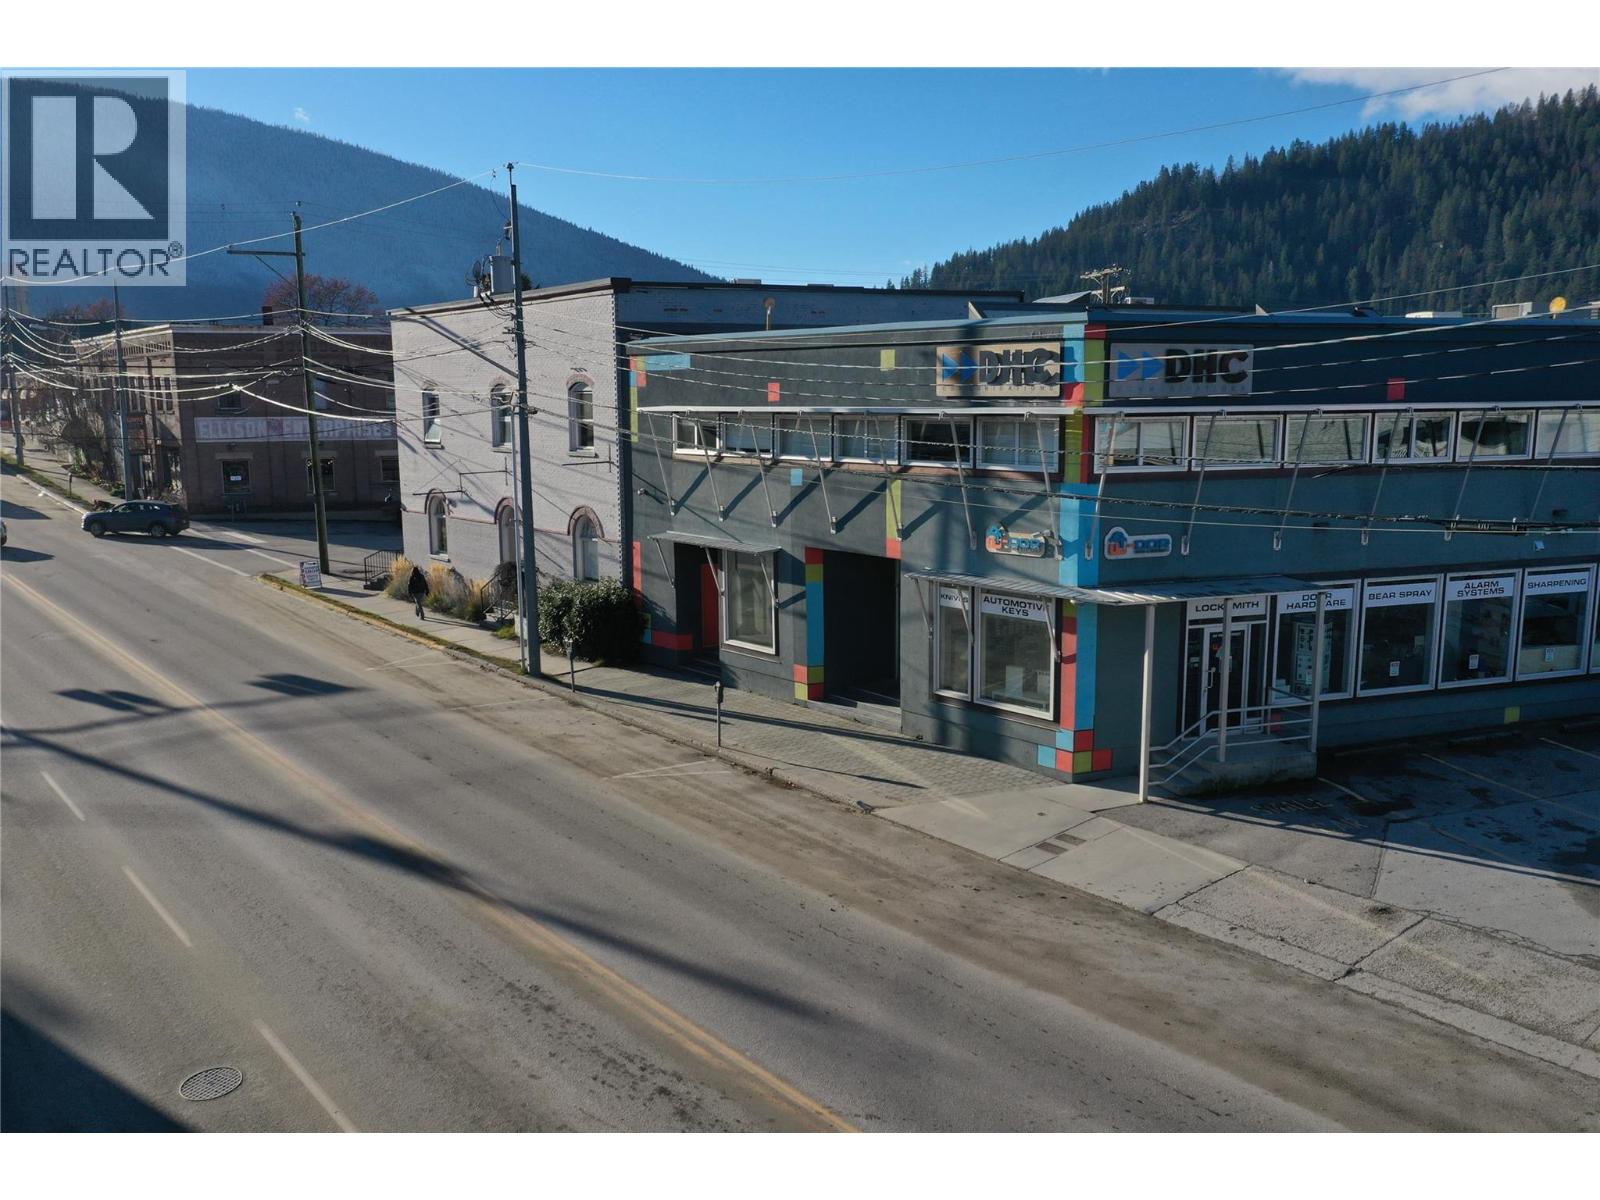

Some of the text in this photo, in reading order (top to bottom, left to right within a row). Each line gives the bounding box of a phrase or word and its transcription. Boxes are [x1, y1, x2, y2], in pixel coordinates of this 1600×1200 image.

[979, 348, 1058, 386] DHC
[1165, 348, 1249, 384] DHC
[199, 420, 267, 438] ELLISON
[1464, 580, 1500, 590] ALARM
[1527, 578, 1587, 590] SHARPENING
[1302, 592, 1332, 602] DOR
[1368, 589, 1432, 601] BEAR SPRAY
[1457, 586, 1505, 598] SYSTEMS
[1195, 600, 1259, 612] LOCKMITH
[1286, 599, 1347, 610] HARDARE
[1001, 606, 1030, 617] KEYS
